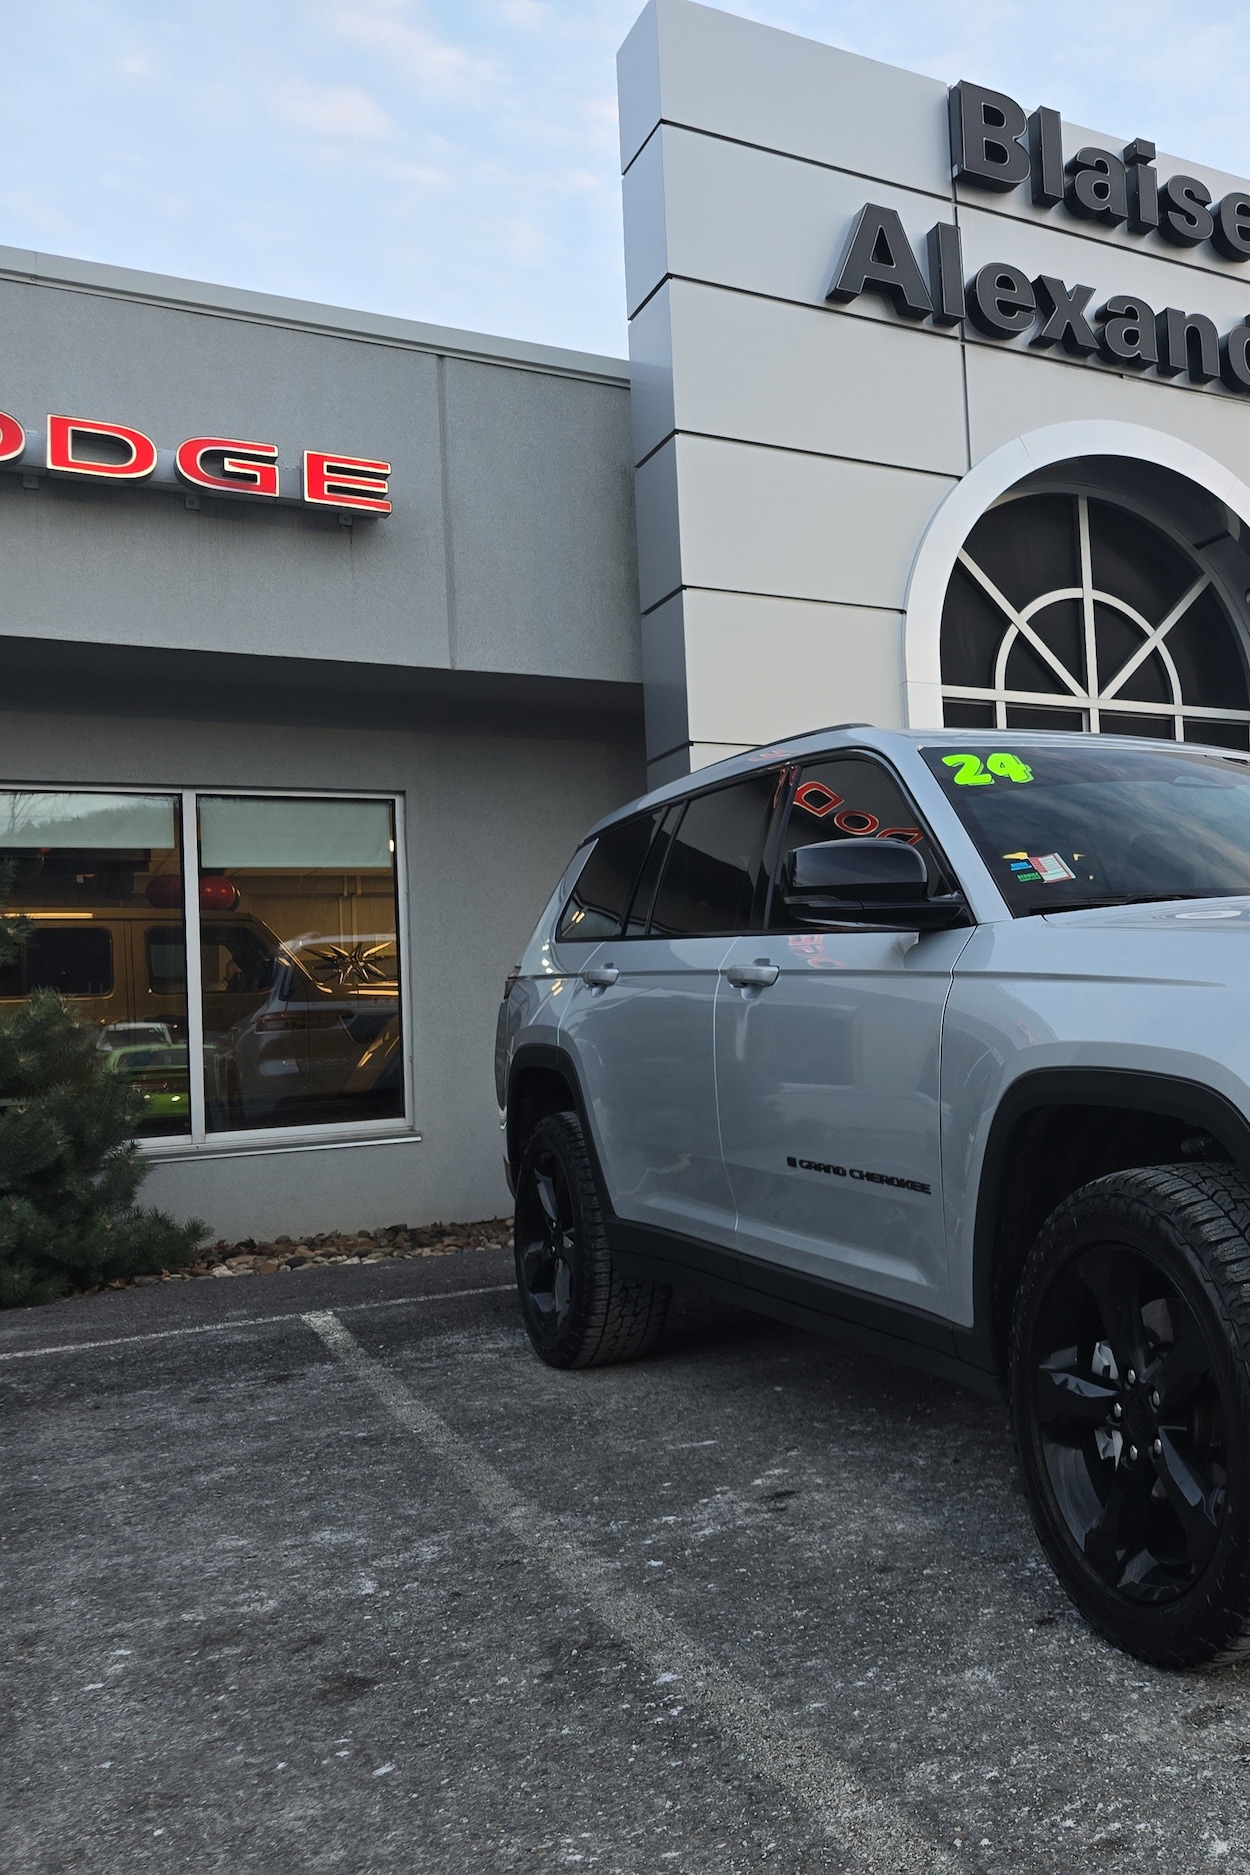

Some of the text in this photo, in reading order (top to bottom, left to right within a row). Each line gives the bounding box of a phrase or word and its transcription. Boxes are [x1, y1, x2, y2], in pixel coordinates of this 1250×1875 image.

[0, 411, 392, 518] DGE
[941, 752, 1035, 786] 24
[799, 1159, 932, 1195] GRAND CHEROKEE
